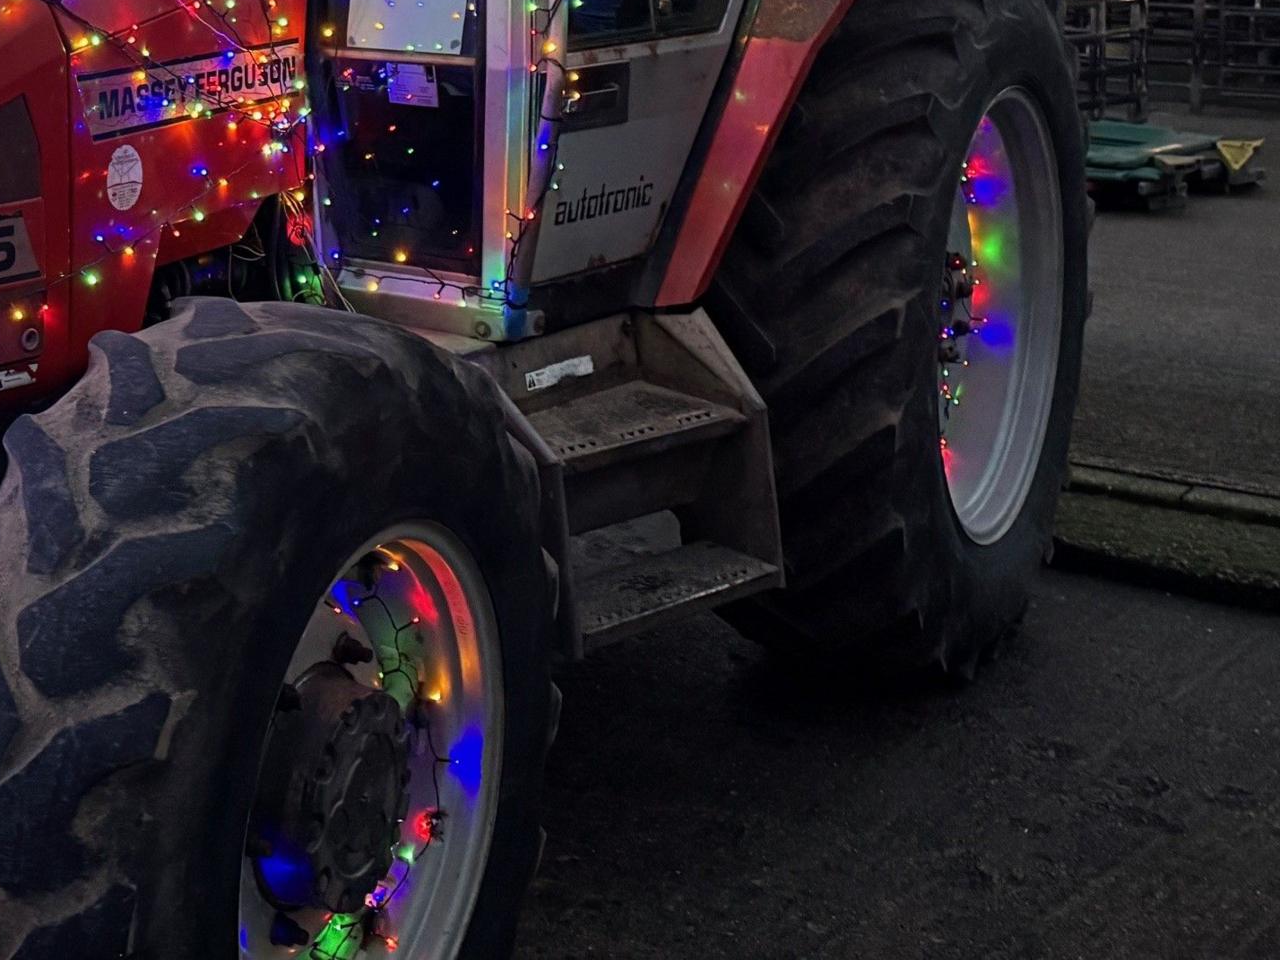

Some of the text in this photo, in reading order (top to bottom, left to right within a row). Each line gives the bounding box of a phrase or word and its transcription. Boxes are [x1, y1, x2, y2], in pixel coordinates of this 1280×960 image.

[99, 74, 188, 120] MASSEY
[195, 55, 296, 97] FERGUSON
[554, 175, 653, 226] autotronic
